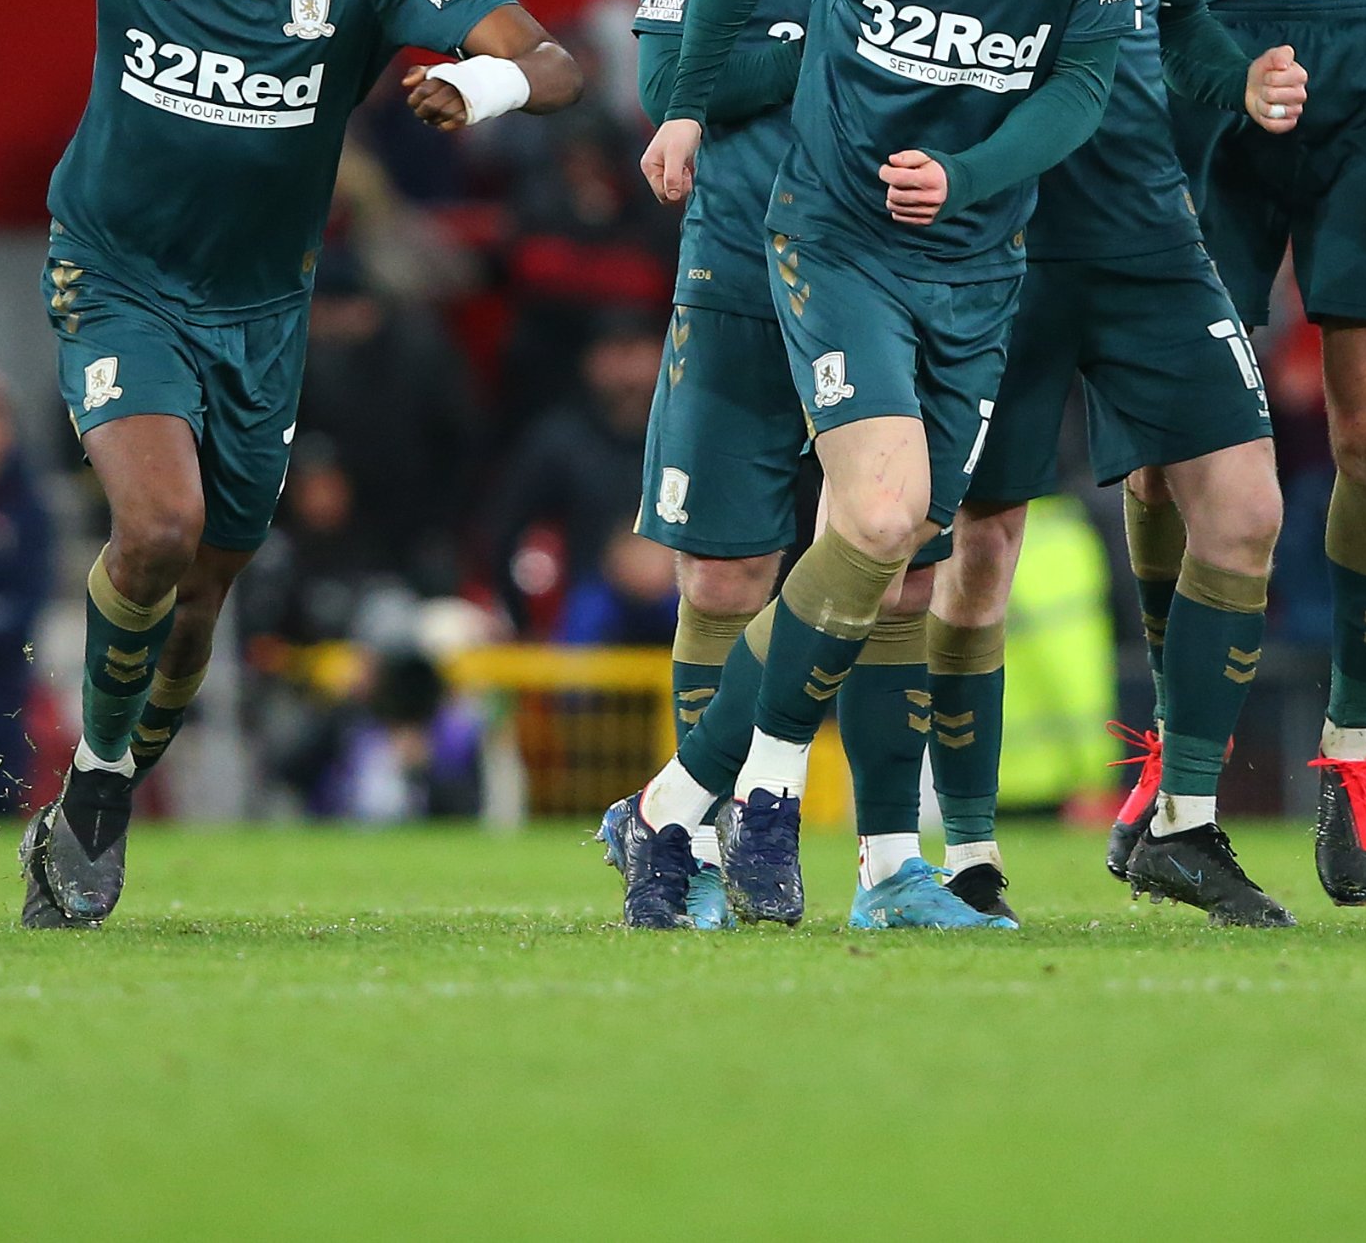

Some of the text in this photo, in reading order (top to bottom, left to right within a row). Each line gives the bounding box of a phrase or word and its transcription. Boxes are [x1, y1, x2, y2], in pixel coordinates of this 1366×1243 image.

[124, 28, 324, 107] 32Red
[890, 58, 1006, 89] SET YOUR LIMITS
[154, 92, 277, 125] SET YOUR LIMITS
